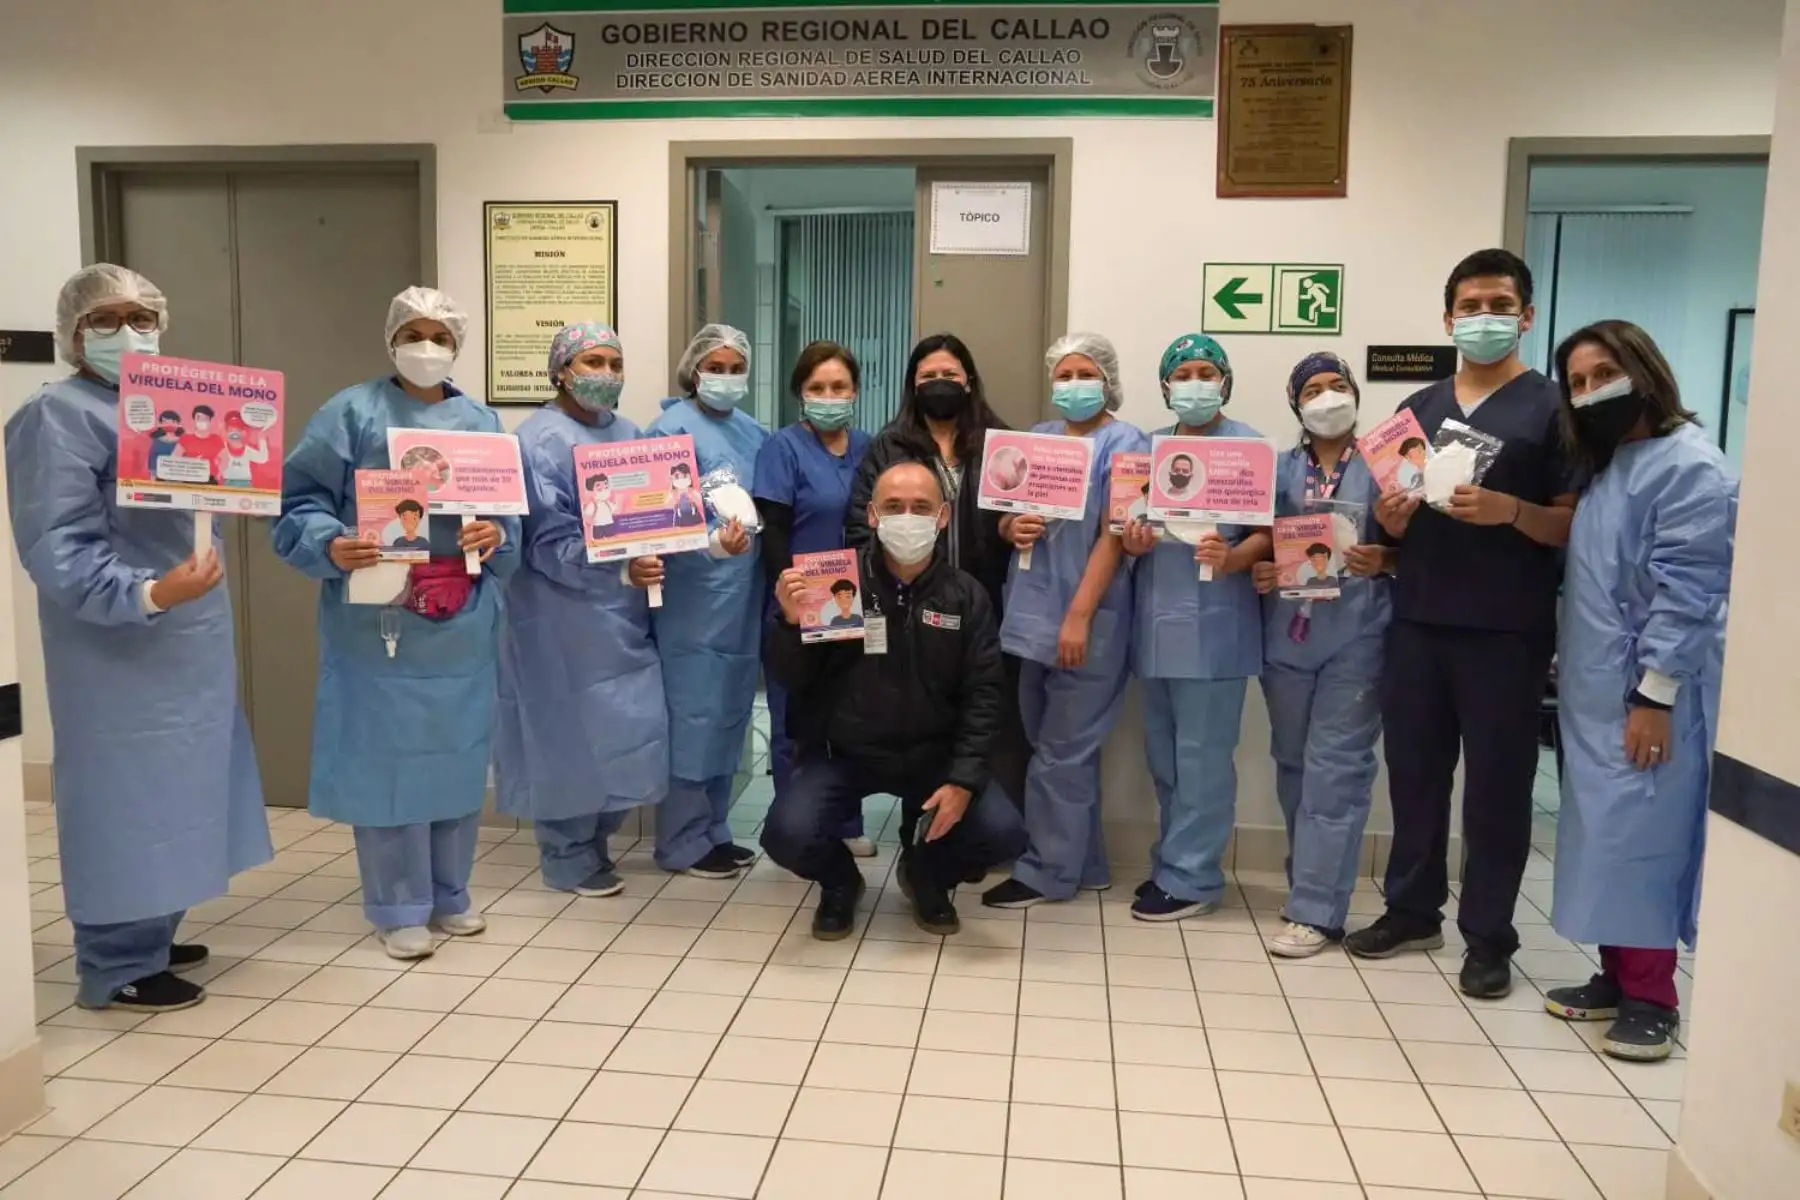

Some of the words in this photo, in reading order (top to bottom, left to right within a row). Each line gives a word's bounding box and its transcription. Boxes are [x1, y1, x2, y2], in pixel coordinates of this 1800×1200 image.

[602, 22, 748, 44] GOBIERNO
[762, 20, 908, 42] REGIONAL
[921, 18, 977, 41] DEL
[990, 18, 1110, 40] CALLAO
[626, 52, 731, 69] DIRECCION
[737, 51, 841, 67] REGIONAL
[846, 50, 872, 65] DE
[878, 50, 945, 65] SALUD
[953, 50, 993, 65] DEL
[998, 49, 1081, 65] CALLAO
[616, 72, 721, 89] DIRECCION
[727, 72, 753, 88] DE
[760, 71, 847, 88] SANIDAD
[853, 70, 921, 87] AEREA
[926, 69, 1092, 87] INTERNACIONAL
[1260, 74, 1333, 88] Aniversario
[534, 249, 566, 258] MISIÓN
[535, 319, 565, 327] VISIÓN
[1371, 353, 1405, 362] Consulta
[141, 362, 224, 382] PROTÉGETE
[228, 373, 246, 385] DE
[249, 376, 266, 387] LA
[500, 370, 534, 378] VALORES
[128, 374, 193, 392] VIRUELA
[197, 382, 225, 396] DEL
[228, 386, 277, 401] MONO
[580, 457, 628, 470] VIRUELA
[630, 454, 653, 466] DEL
[653, 450, 691, 463] MONO
